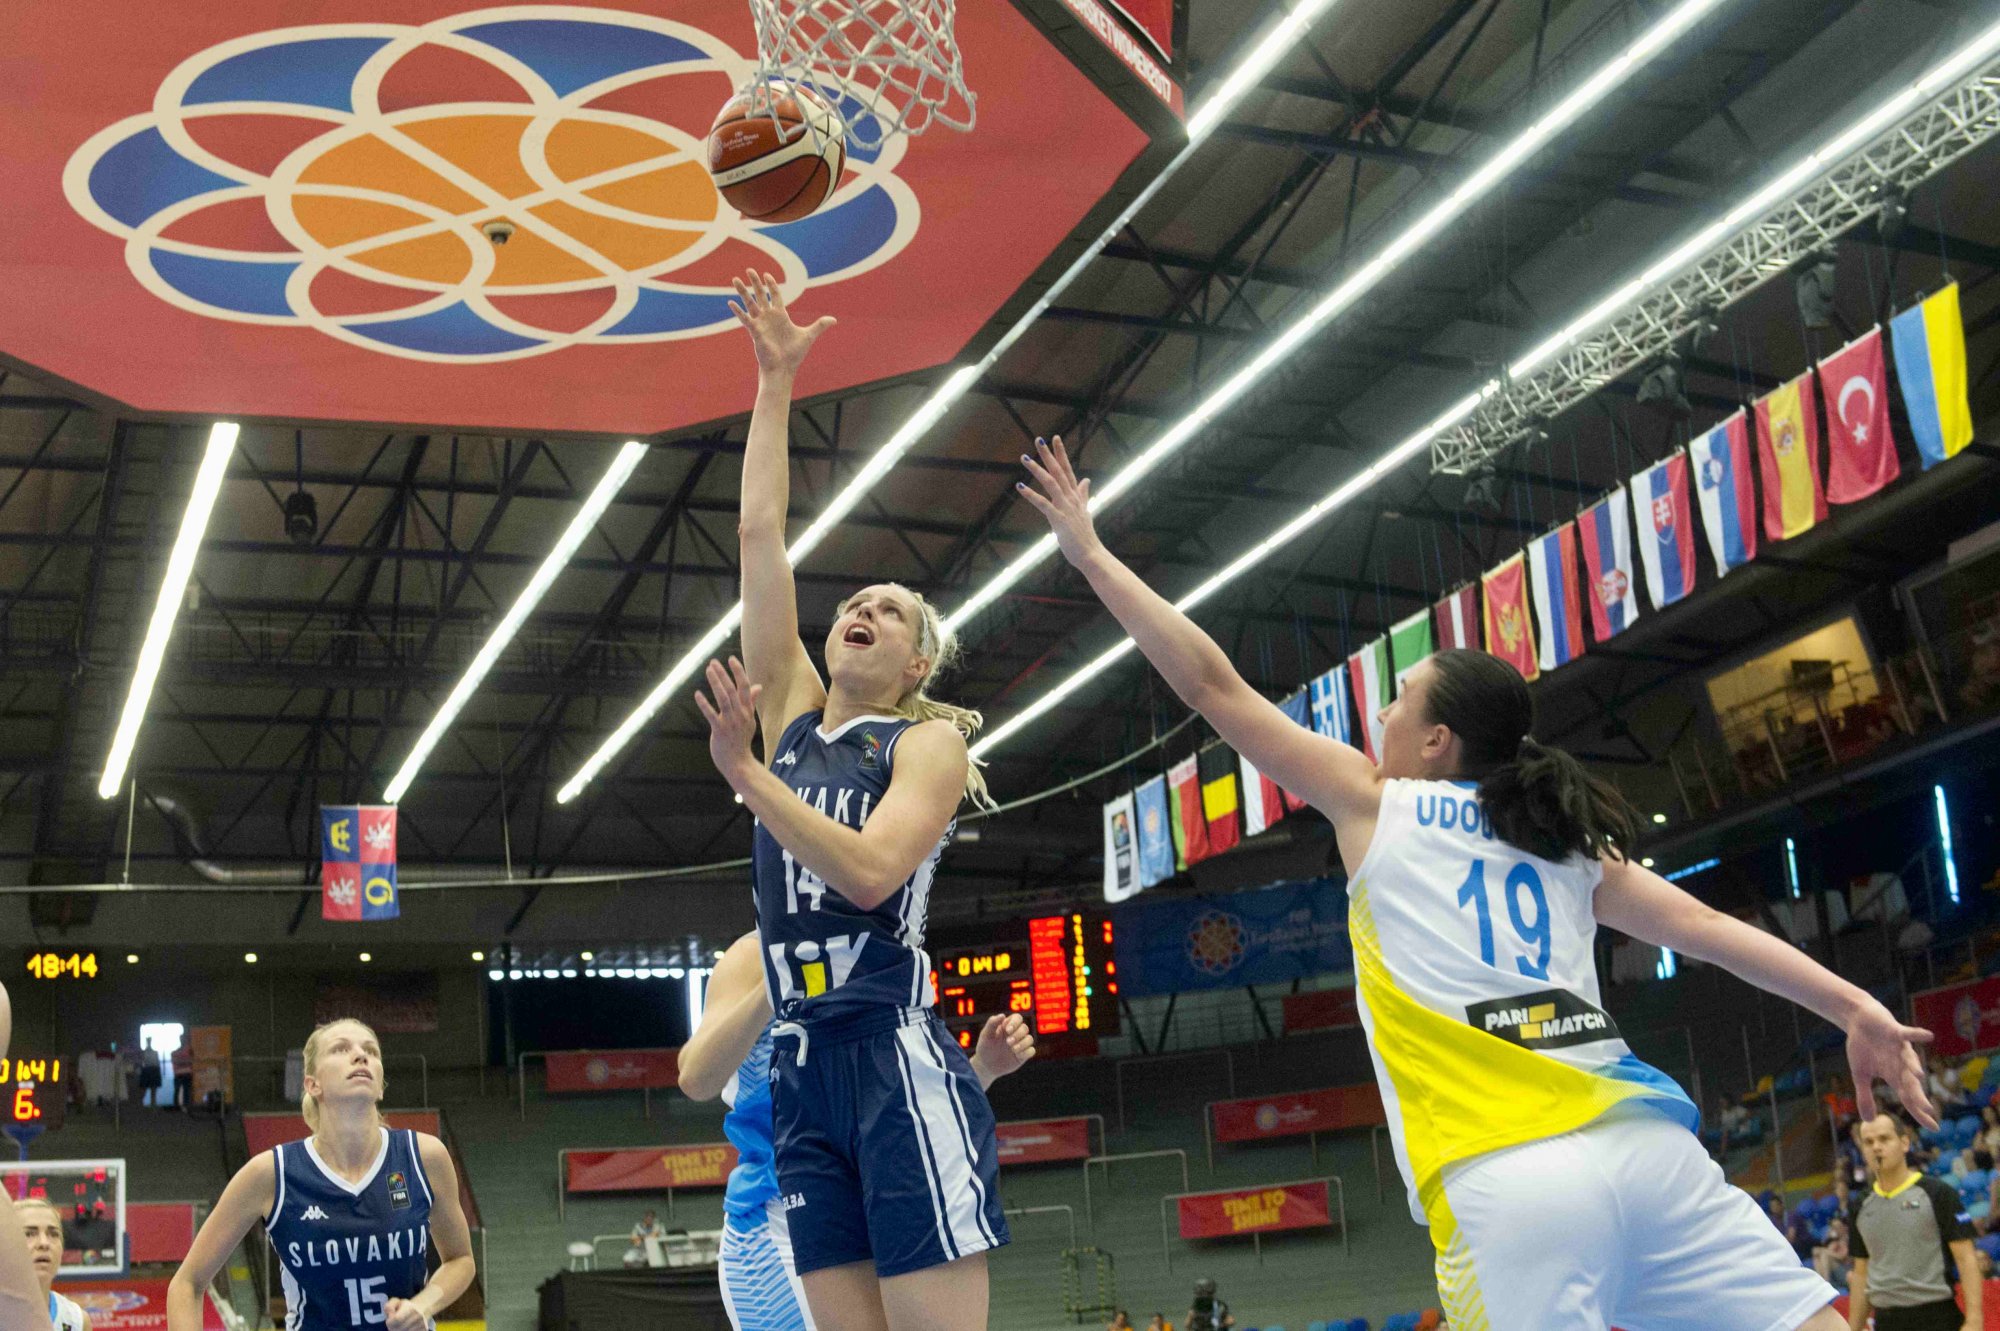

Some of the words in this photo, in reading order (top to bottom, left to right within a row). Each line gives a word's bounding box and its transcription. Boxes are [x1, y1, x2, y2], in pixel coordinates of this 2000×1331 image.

[782, 848, 827, 914] 14
[1457, 858, 1551, 982] 19
[27, 953, 98, 979] 18:14
[958, 998, 975, 1016] 11
[1010, 991, 1032, 1012] 20
[1484, 1007, 1529, 1032] PARI
[1541, 1012, 1607, 1039] MATCH
[288, 1224, 428, 1268] SLOVAKIA
[343, 1275, 389, 1326] 15
